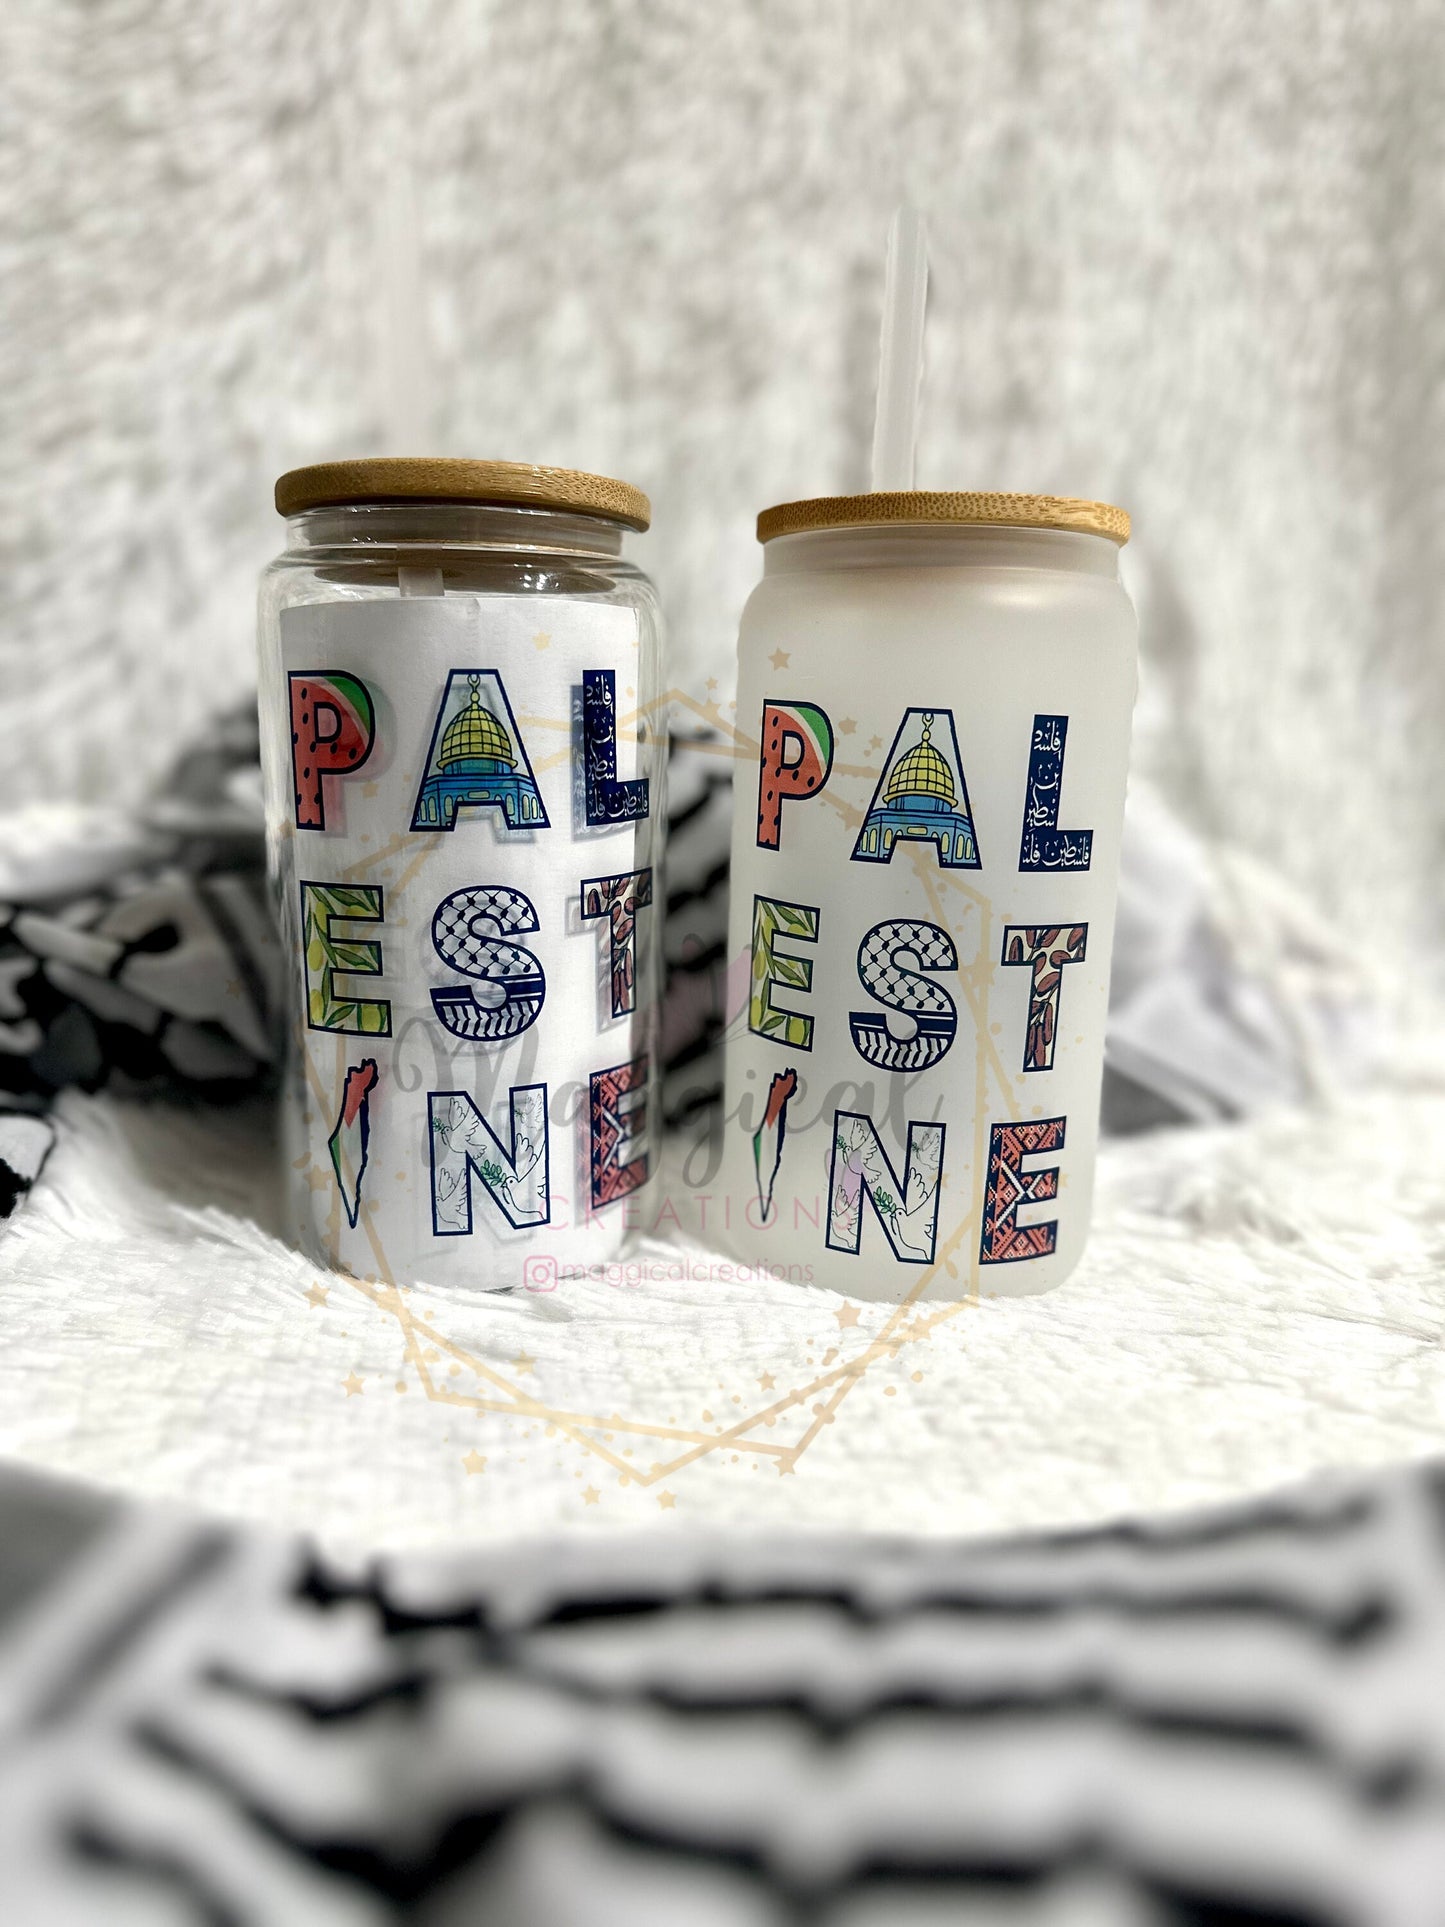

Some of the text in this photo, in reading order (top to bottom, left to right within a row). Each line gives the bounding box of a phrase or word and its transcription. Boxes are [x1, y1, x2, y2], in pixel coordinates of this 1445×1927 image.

[288, 669, 650, 832] PAL
[757, 699, 1092, 871] PAL
[301, 868, 652, 1040] EST
[749, 895, 1089, 1072] EST
